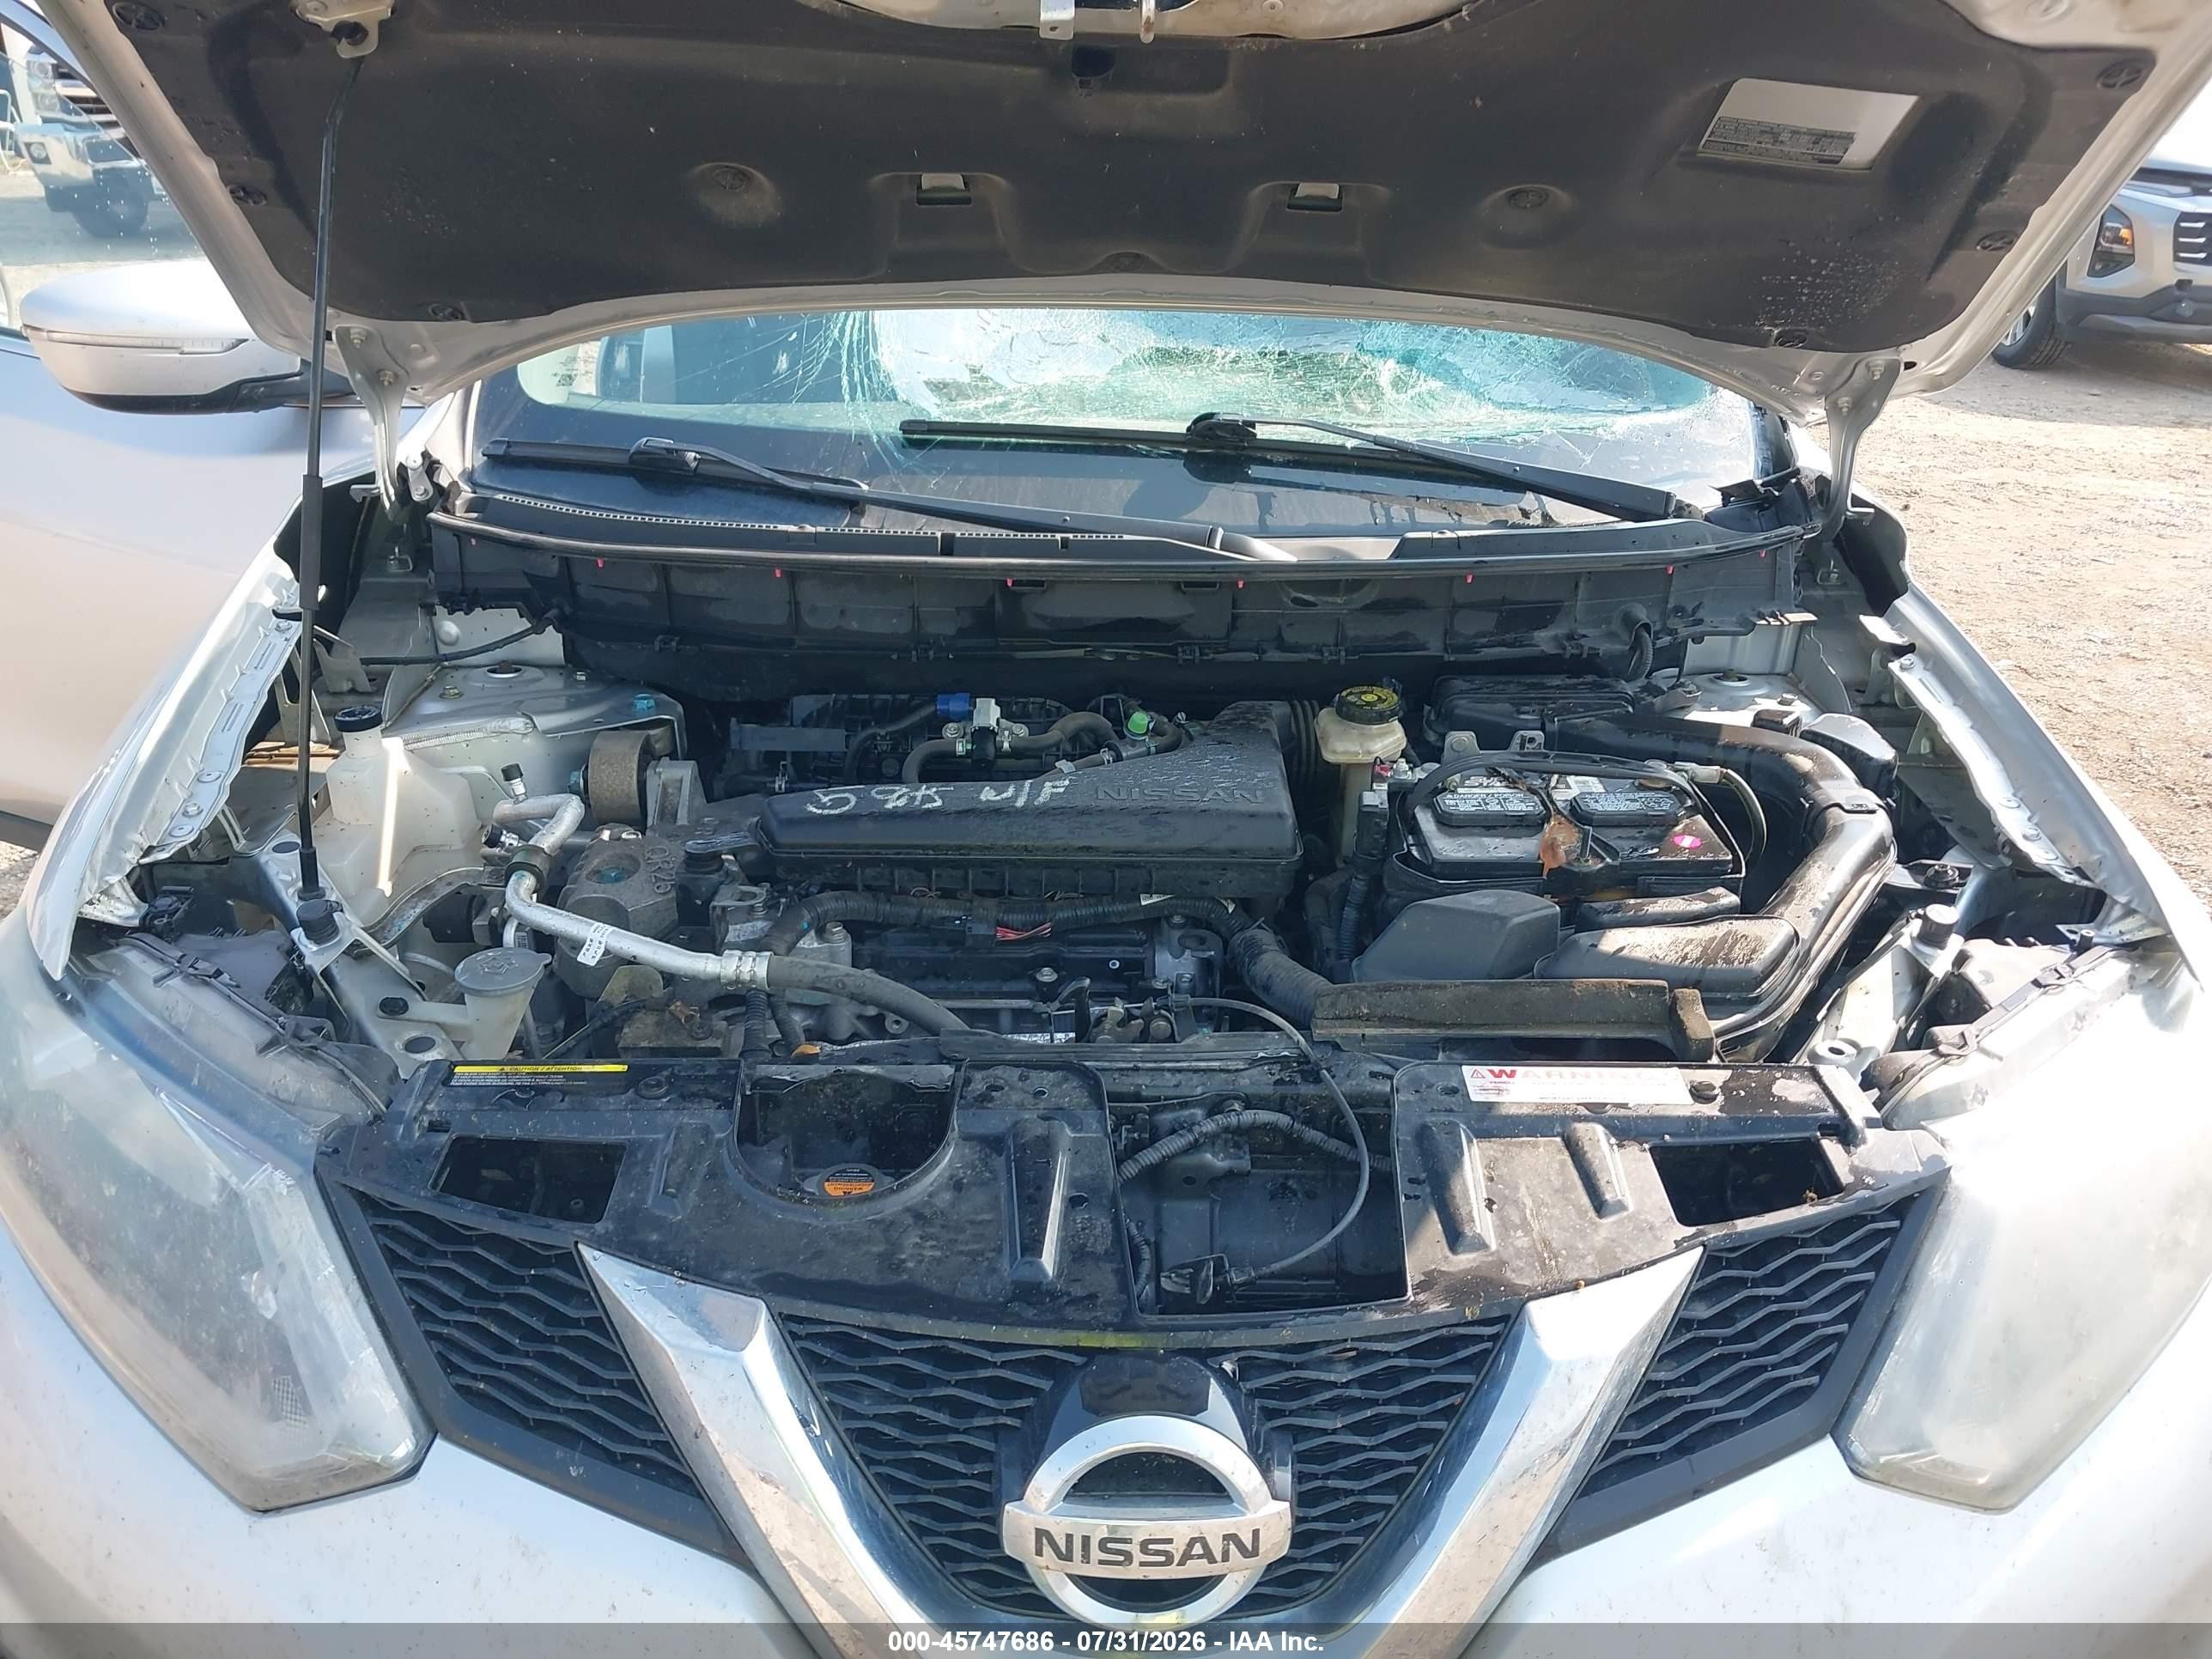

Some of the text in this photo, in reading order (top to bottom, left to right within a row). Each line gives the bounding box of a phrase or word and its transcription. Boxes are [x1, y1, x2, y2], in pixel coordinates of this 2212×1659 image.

[1096, 785, 1266, 804] NISSAN
[645, 845, 676, 894] QR25
[1034, 1527, 1261, 1568] NISSAN
